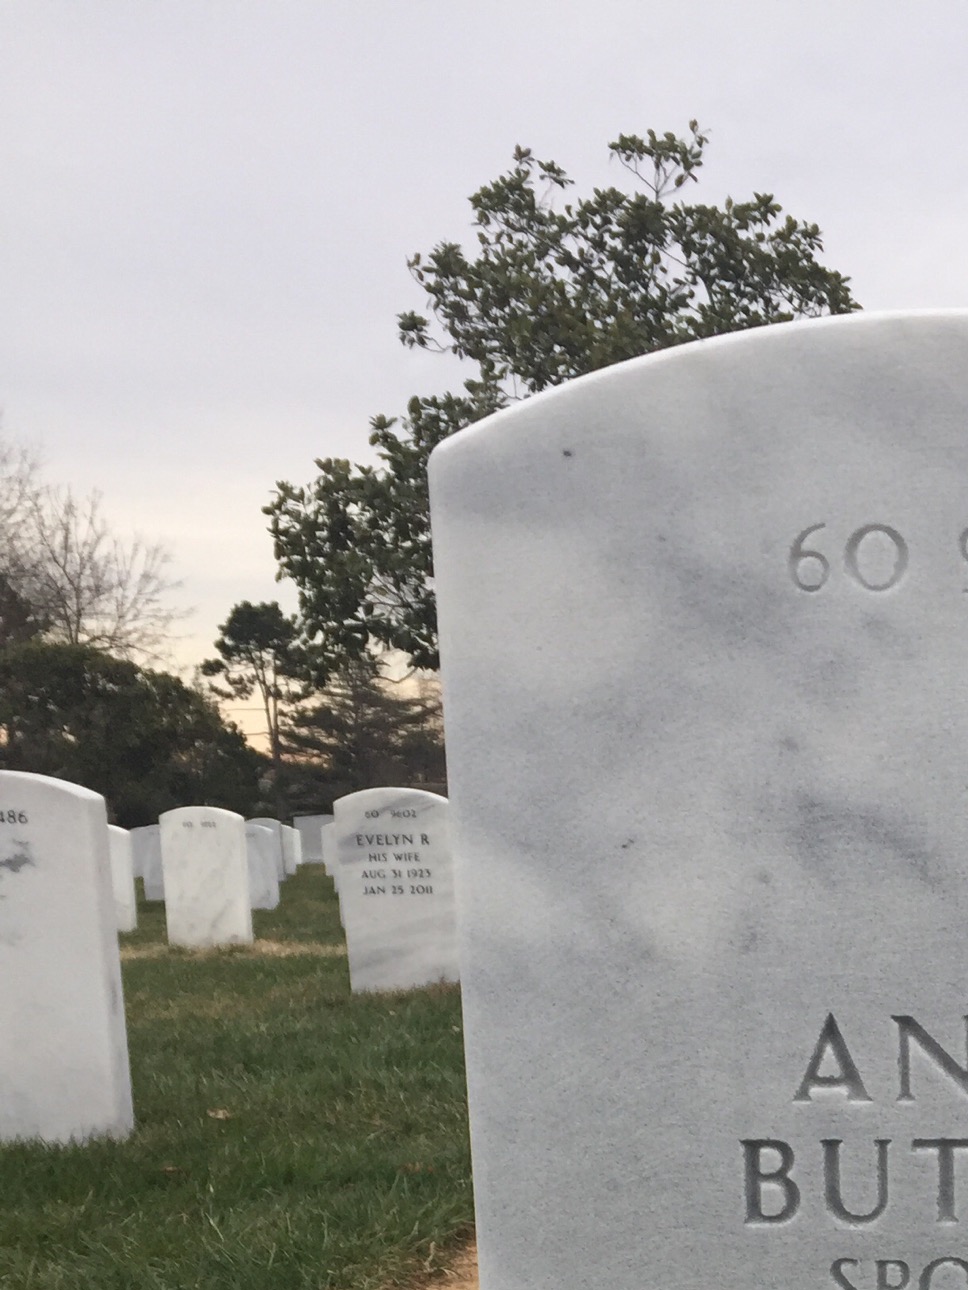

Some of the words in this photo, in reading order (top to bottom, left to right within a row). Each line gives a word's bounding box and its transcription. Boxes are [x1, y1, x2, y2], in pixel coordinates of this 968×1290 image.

[787, 522, 909, 594] 60
[355, 833, 414, 846] EVELYN
[420, 833, 430, 845] R
[368, 852, 388, 862] HIS
[392, 852, 421, 862] WIFE
[361, 868, 386, 879] AUG
[391, 868, 402, 878] 31
[407, 868, 431, 878] 1923
[363, 885, 386, 895] JAN
[391, 885, 404, 894] 25
[410, 884, 433, 894] 2011
